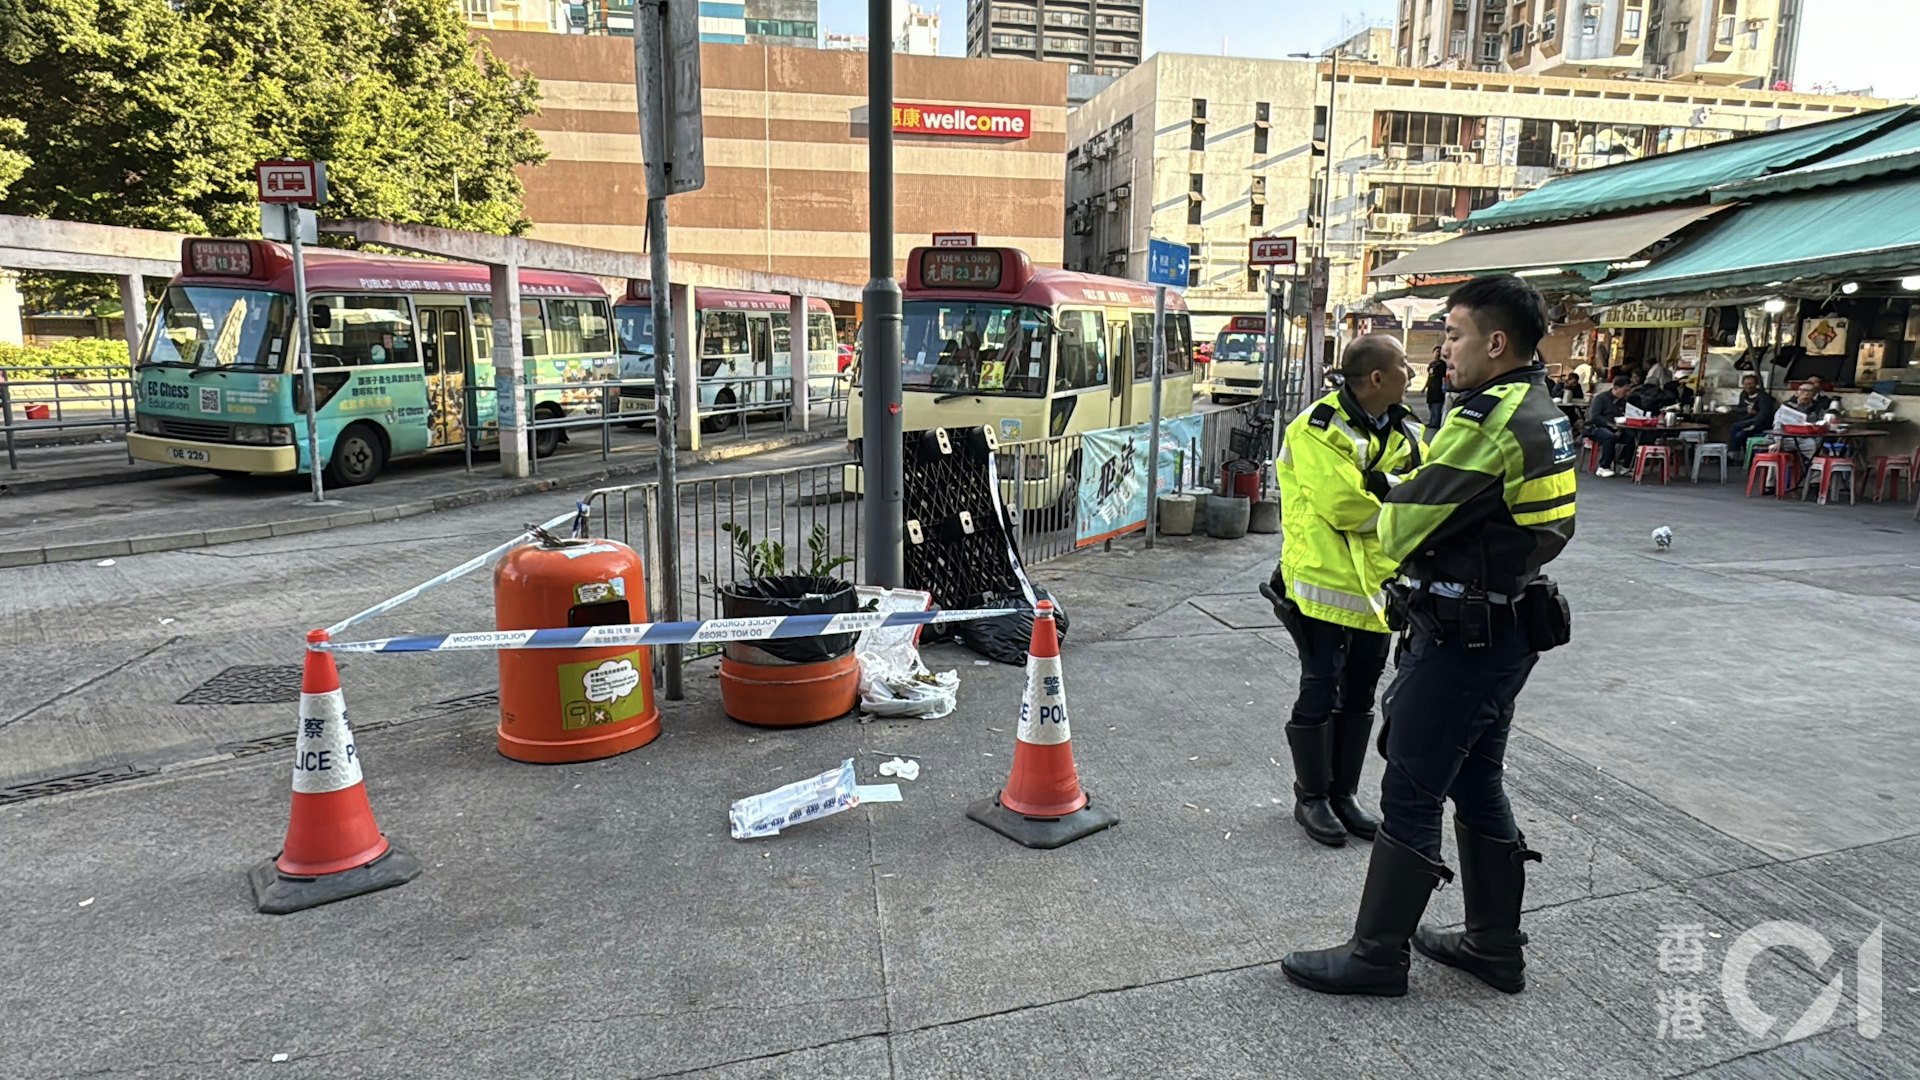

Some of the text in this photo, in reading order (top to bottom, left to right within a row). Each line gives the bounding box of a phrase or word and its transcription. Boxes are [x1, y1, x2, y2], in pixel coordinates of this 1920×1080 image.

[892, 106, 1025, 132] 惠康 wellcome
[936, 254, 991, 263] YUEN LONG
[359, 278, 392, 289] PUBLIC
[396, 279, 422, 290] LIGHT
[423, 280, 441, 291] BUS
[458, 281, 483, 292] SEATS
[147, 381, 189, 399] EC Chess
[148, 398, 190, 412] Education
[173, 448, 204, 461] DE 226
[1043, 675, 1060, 696] 警
